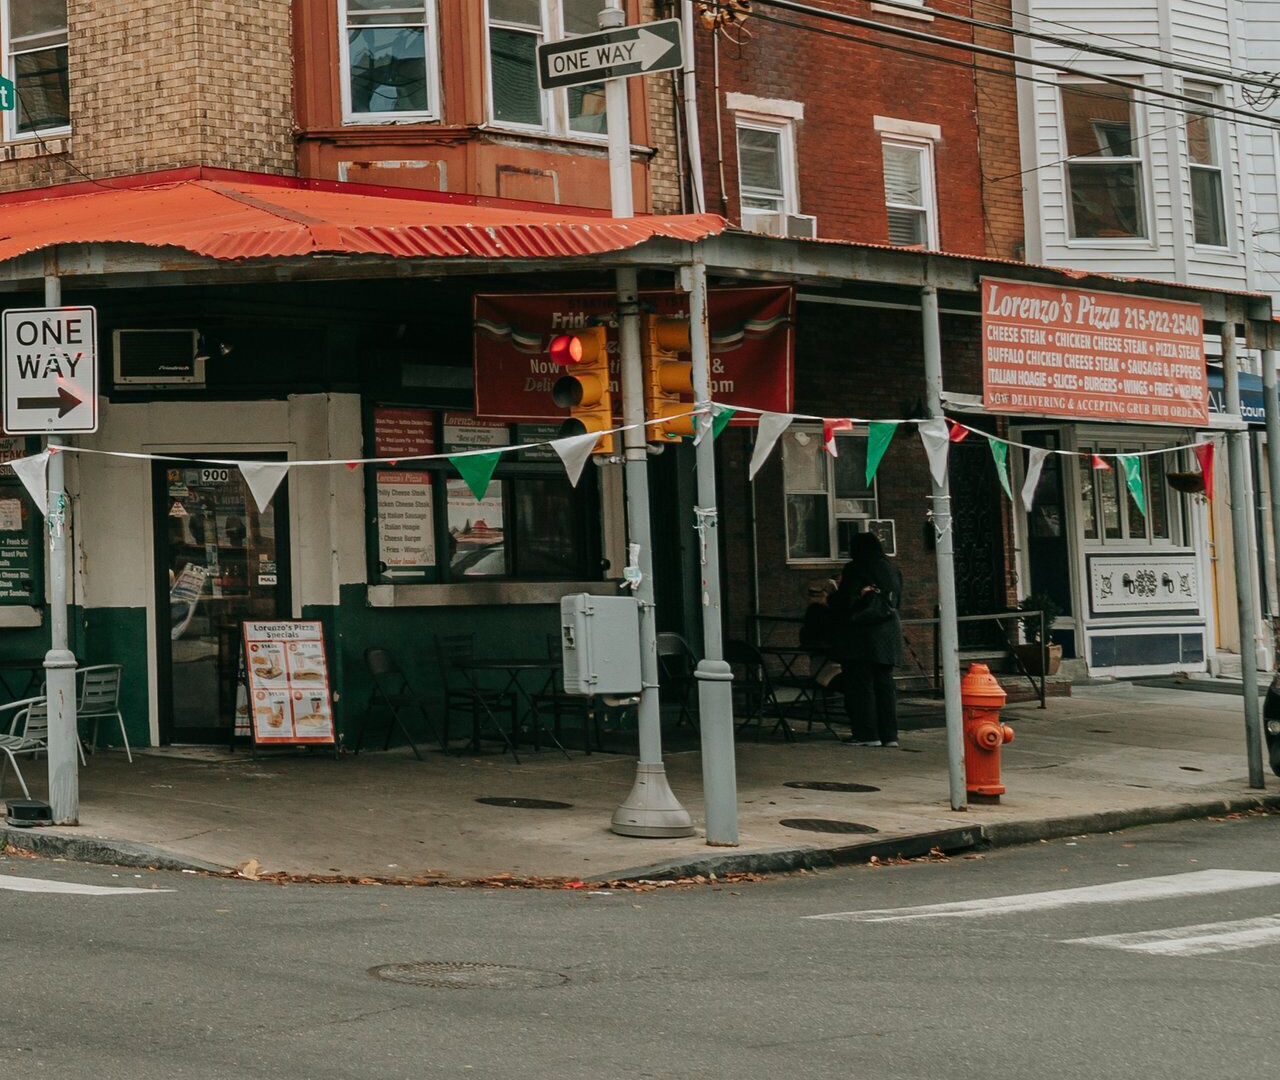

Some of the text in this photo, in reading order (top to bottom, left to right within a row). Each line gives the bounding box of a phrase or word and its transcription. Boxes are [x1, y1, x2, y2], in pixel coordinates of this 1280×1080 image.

[554, 42, 636, 73] ONE WAY
[987, 285, 1199, 337] Lorenzo's Pizza 215-922-2540
[16, 319, 82, 346] ONE
[987, 325, 1200, 360] CHEESE STEAK CHICKEN CHEESE STEAK PIZZA STEAK
[17, 352, 82, 379] WAY
[530, 359, 560, 374] Now
[988, 348, 1202, 380] BUFFALO CHICKEN CHEESE STEAK SAUSAGE & PEPPERS
[988, 368, 1016, 385] ITALIAN
[1018, 370, 1047, 387] HOAGIE
[1053, 374, 1078, 390] SLICES
[1084, 377, 1117, 393] BURGERS
[1123, 380, 1148, 396] WINGS
[1154, 382, 1173, 397] FRIES
[989, 392, 1169, 415] NOW DELIVERING & ACCEPTING GRUB HUB
[203, 470, 227, 480] 900
